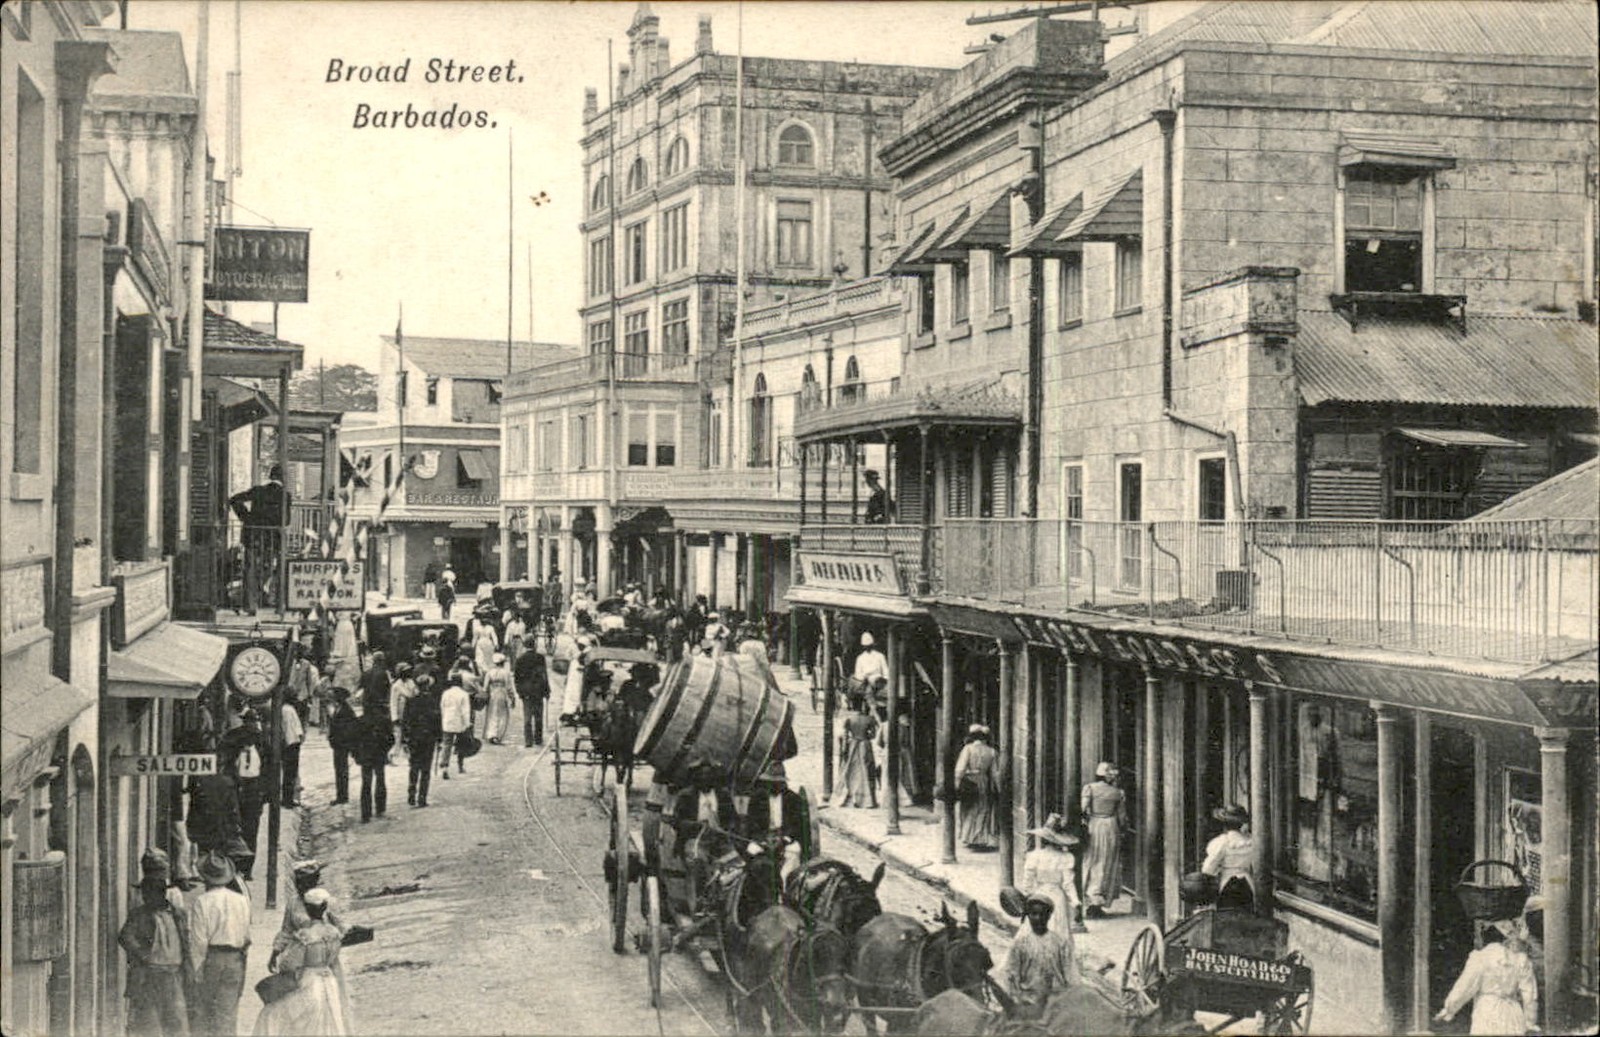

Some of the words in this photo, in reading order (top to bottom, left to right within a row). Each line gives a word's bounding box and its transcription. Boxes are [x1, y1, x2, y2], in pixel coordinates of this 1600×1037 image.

[1388, 670, 1514, 715] GROCERS
[136, 756, 213, 773] SALOON
[1186, 948, 1227, 965] JOHN
[1229, 954, 1269, 972] HOAD
